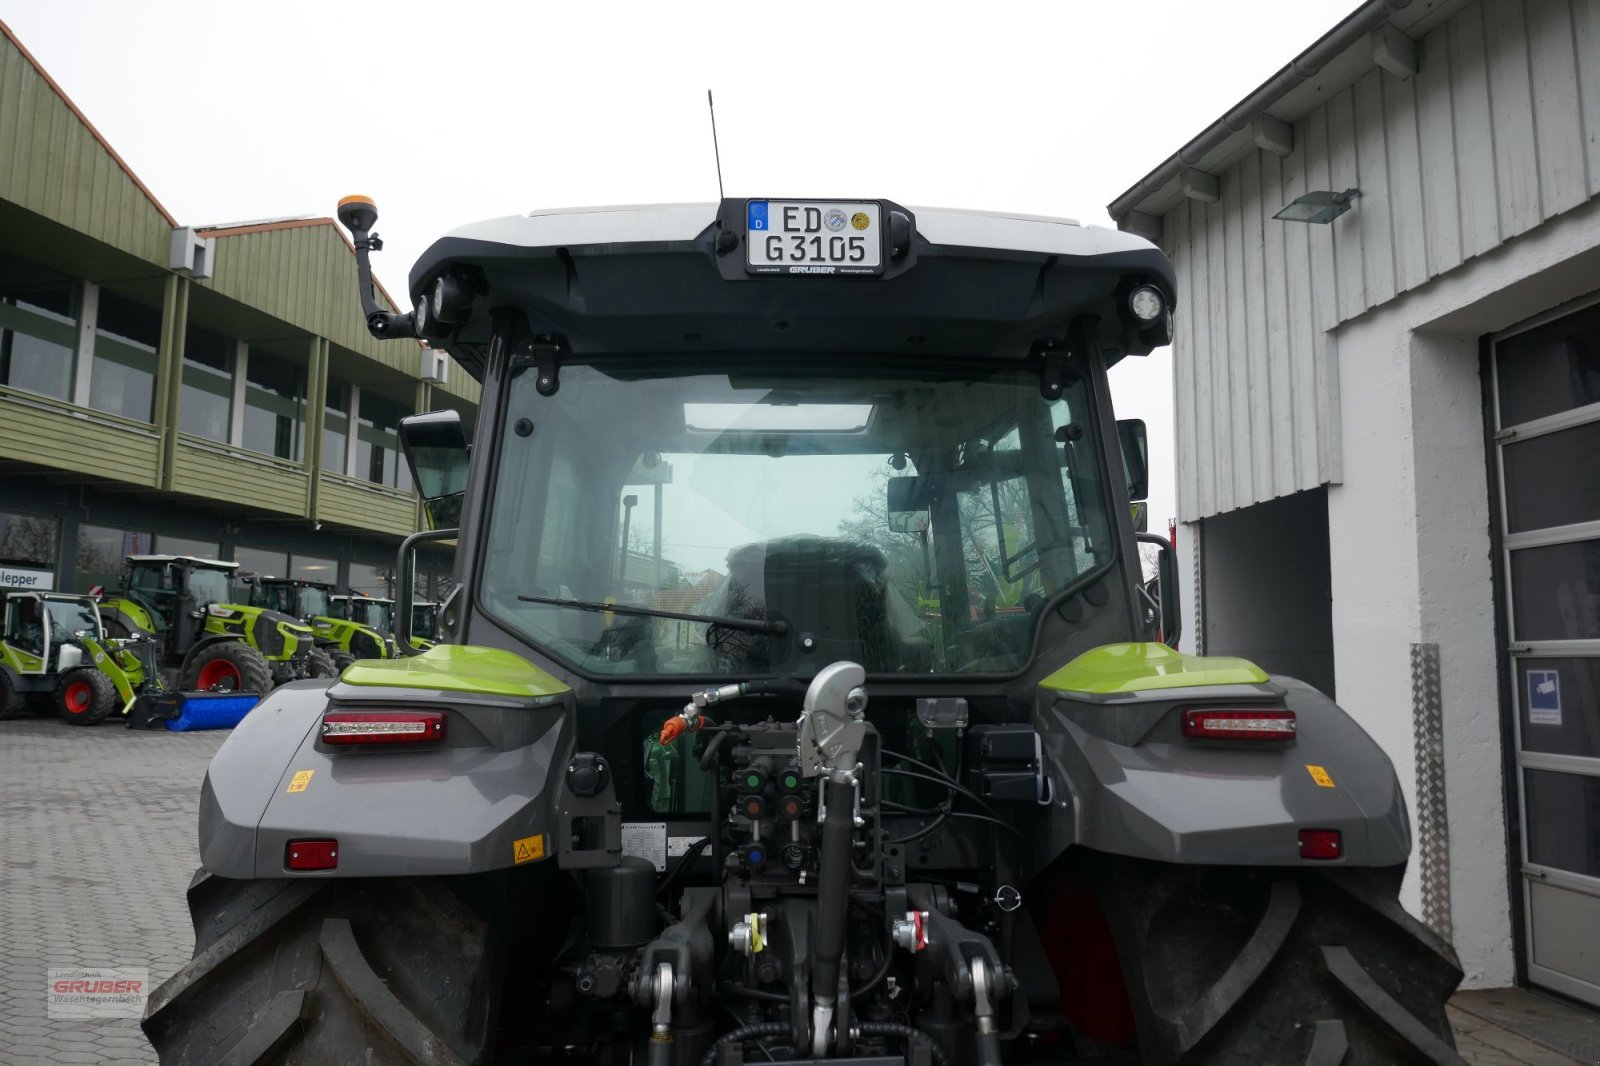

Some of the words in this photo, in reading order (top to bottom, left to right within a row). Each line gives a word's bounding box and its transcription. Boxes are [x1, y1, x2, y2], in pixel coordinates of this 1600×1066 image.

[755, 219, 763, 229] D
[783, 206, 822, 232] ED
[789, 266, 836, 274] GRUBER
[0, 571, 38, 588] lepper
